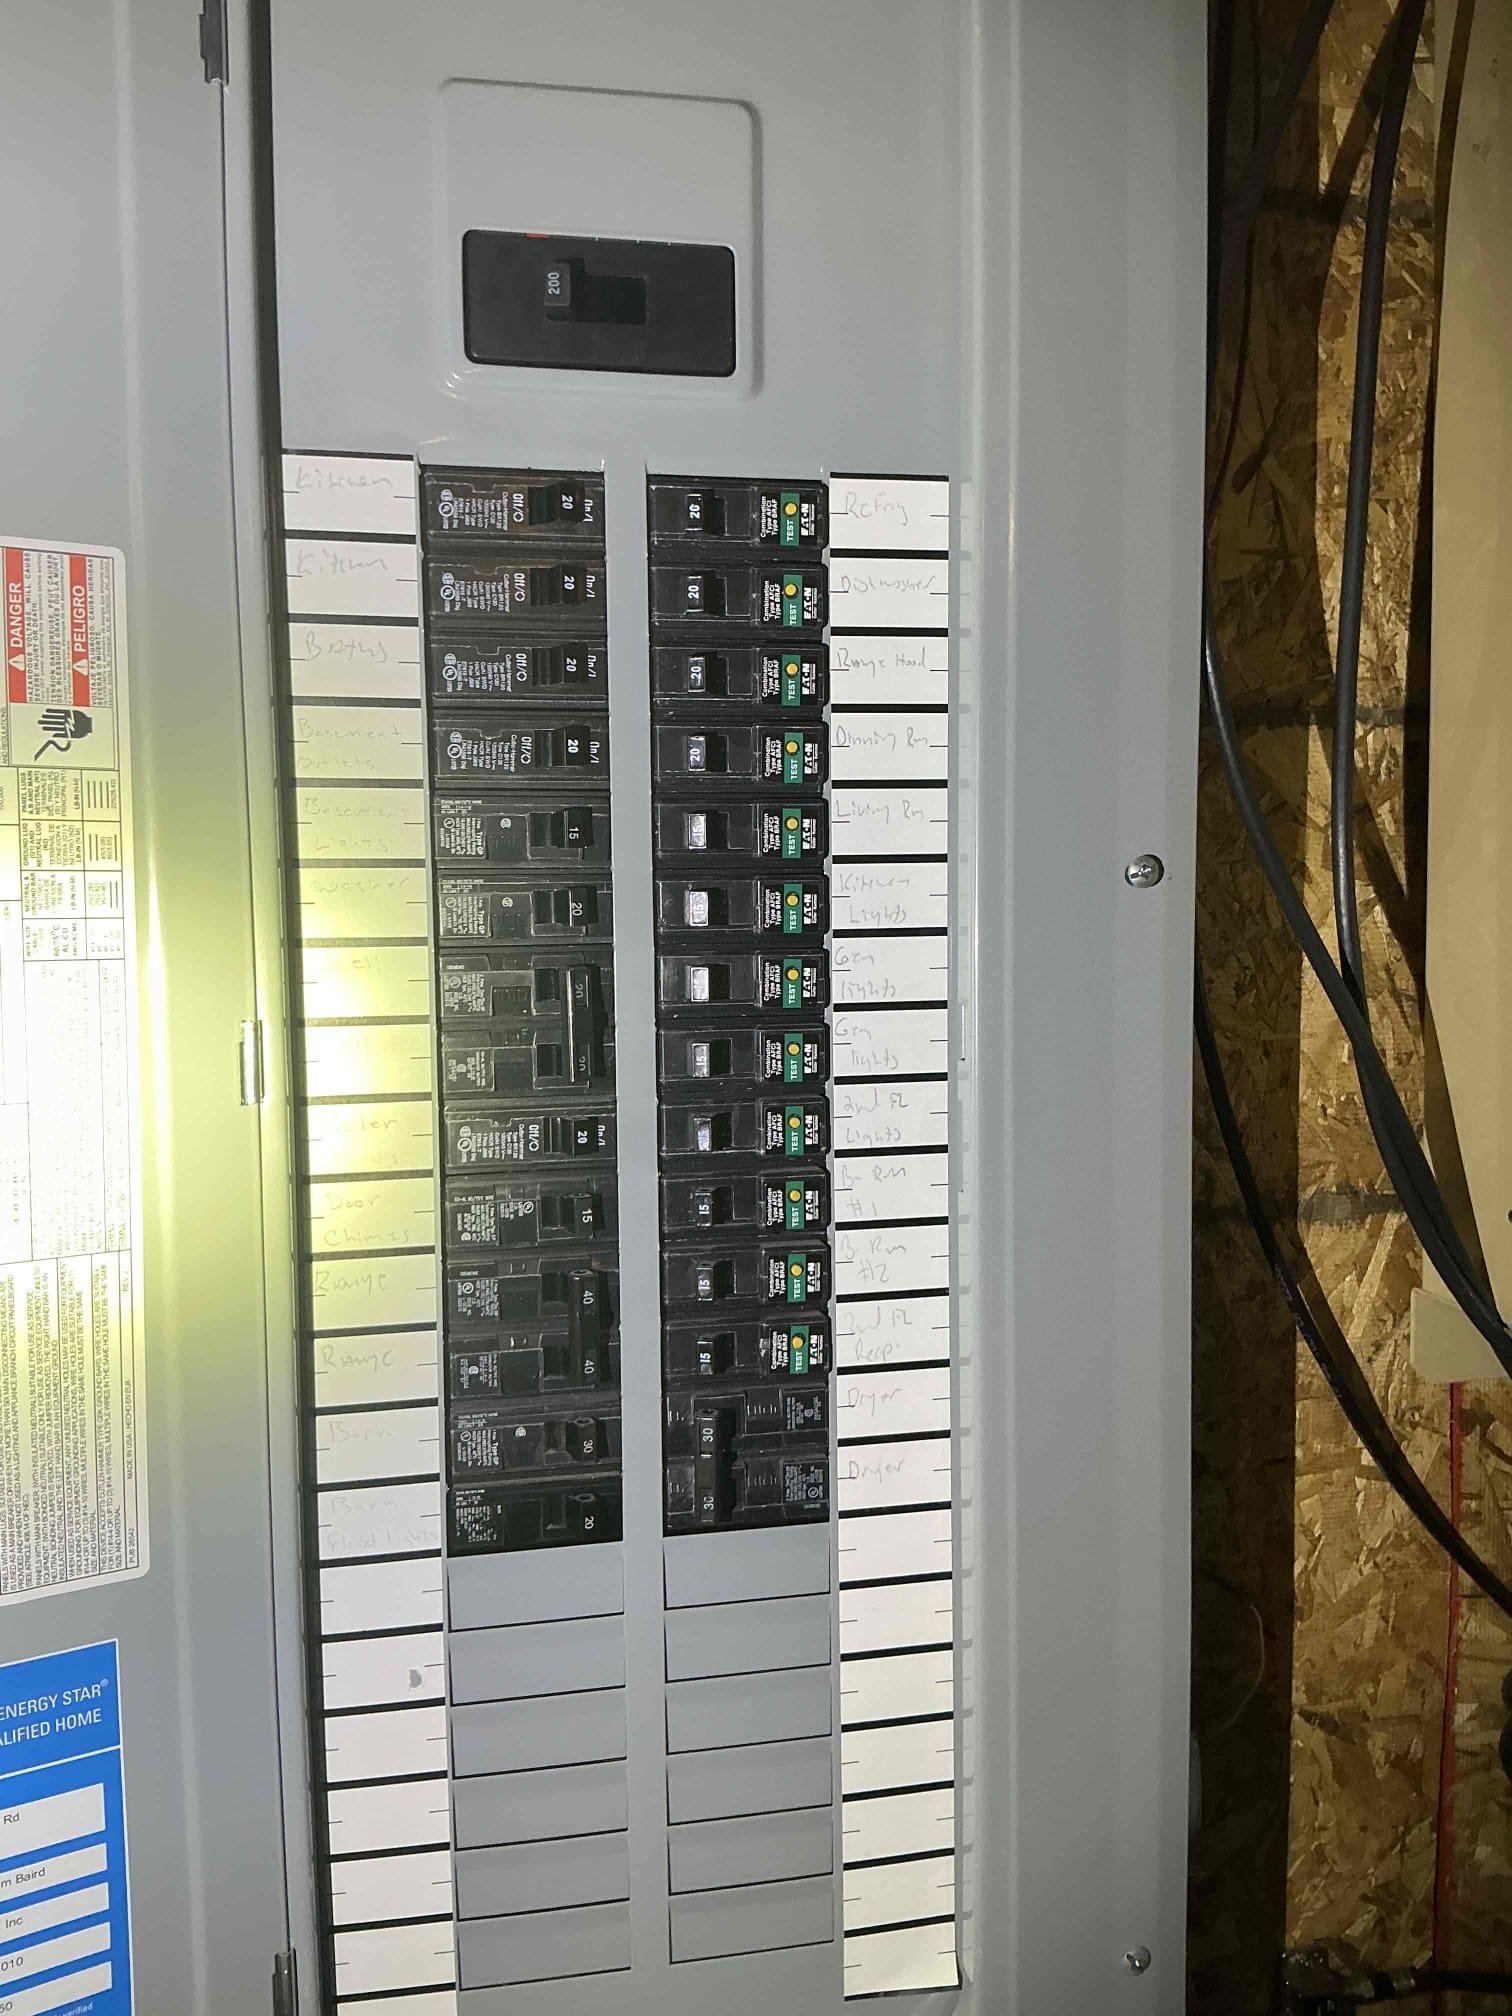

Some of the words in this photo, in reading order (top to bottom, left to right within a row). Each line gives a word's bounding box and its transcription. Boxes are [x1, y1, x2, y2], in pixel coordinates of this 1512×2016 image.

[548, 272, 560, 295] 200
[561, 495, 573, 509] 20
[801, 504, 809, 536] EATON
[564, 576, 575, 590] 20
[688, 585, 700, 599] 20
[9, 582, 23, 647] DANGER
[72, 586, 86, 652] PELIGRO
[567, 658, 577, 672] 20
[691, 666, 701, 679] 20
[568, 740, 578, 753] 20
[690, 748, 700, 762] 20
[804, 743, 812, 774] EATON
[836, 799, 890, 824] Living
[569, 827, 579, 840] 15
[572, 903, 582, 916] 20
[696, 1056, 706, 1066] 15
[804, 1044, 812, 1074] EATON
[805, 1115, 813, 1145] EATON
[577, 1131, 588, 1144] 20
[791, 1132, 799, 1152] TEST
[582, 1209, 592, 1223] 15
[699, 1204, 709, 1214] 15
[699, 1279, 710, 1290] 15
[583, 1290, 593, 1304] 40
[810, 1335, 818, 1365] EATON
[700, 1352, 711, 1363] 15
[584, 1360, 594, 1374] 40
[848, 1387, 902, 1416] Dryer
[703, 1428, 714, 1442] 30
[583, 1440, 593, 1453] 30
[848, 1460, 905, 1484] Dryer
[585, 1516, 594, 1529] 20
[0, 1694, 58, 1720] ENERGY
[55, 1708, 102, 1732] HOME
[3, 1812, 20, 1824] Rd
[15, 1867, 46, 1884] Baird
[5, 1917, 23, 1929] Inc
[1, 1956, 24, 1972] 010
